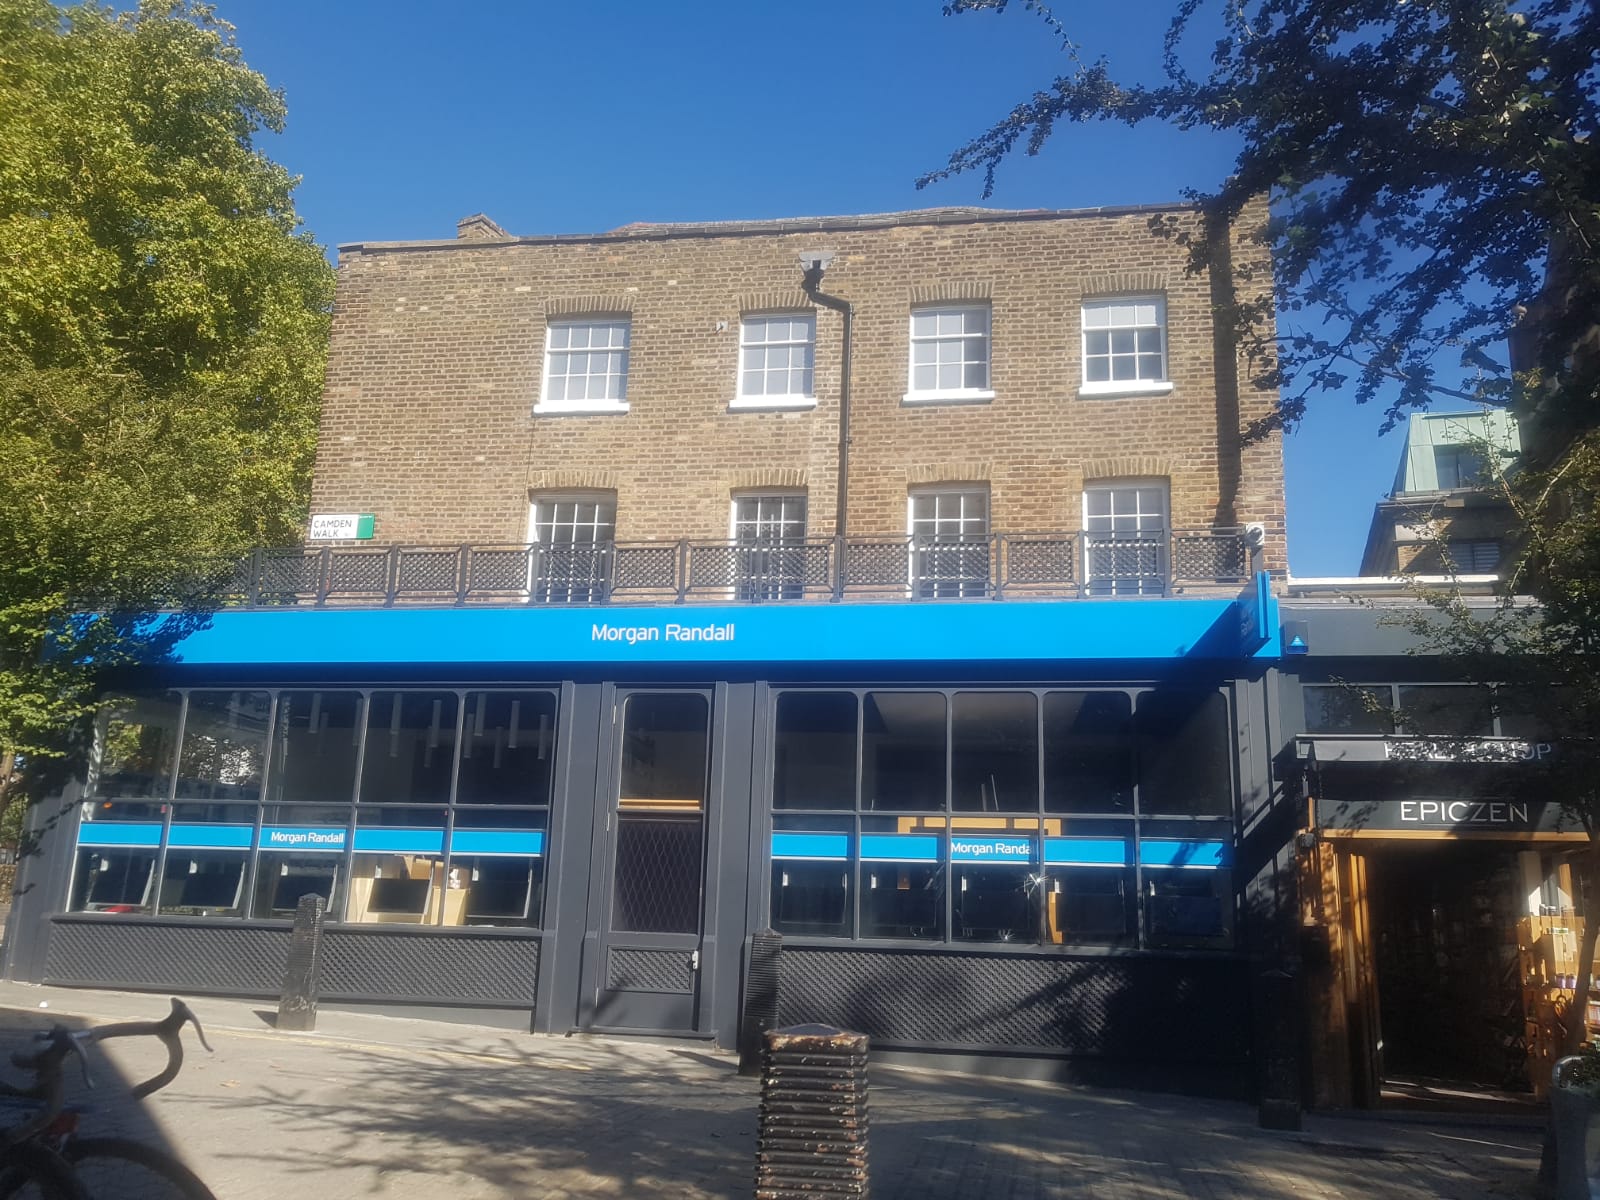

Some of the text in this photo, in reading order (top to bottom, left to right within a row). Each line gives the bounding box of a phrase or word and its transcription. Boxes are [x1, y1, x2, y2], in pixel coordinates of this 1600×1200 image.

[313, 519, 352, 528] CAMDEN
[313, 529, 339, 538] WALK
[591, 623, 735, 645] Morgan Randall
[1384, 742, 1475, 758] HEALH
[1400, 801, 1528, 823] EPICZEN
[271, 831, 344, 844] Morgan Randall
[951, 842, 1031, 856] Morgan Randa
